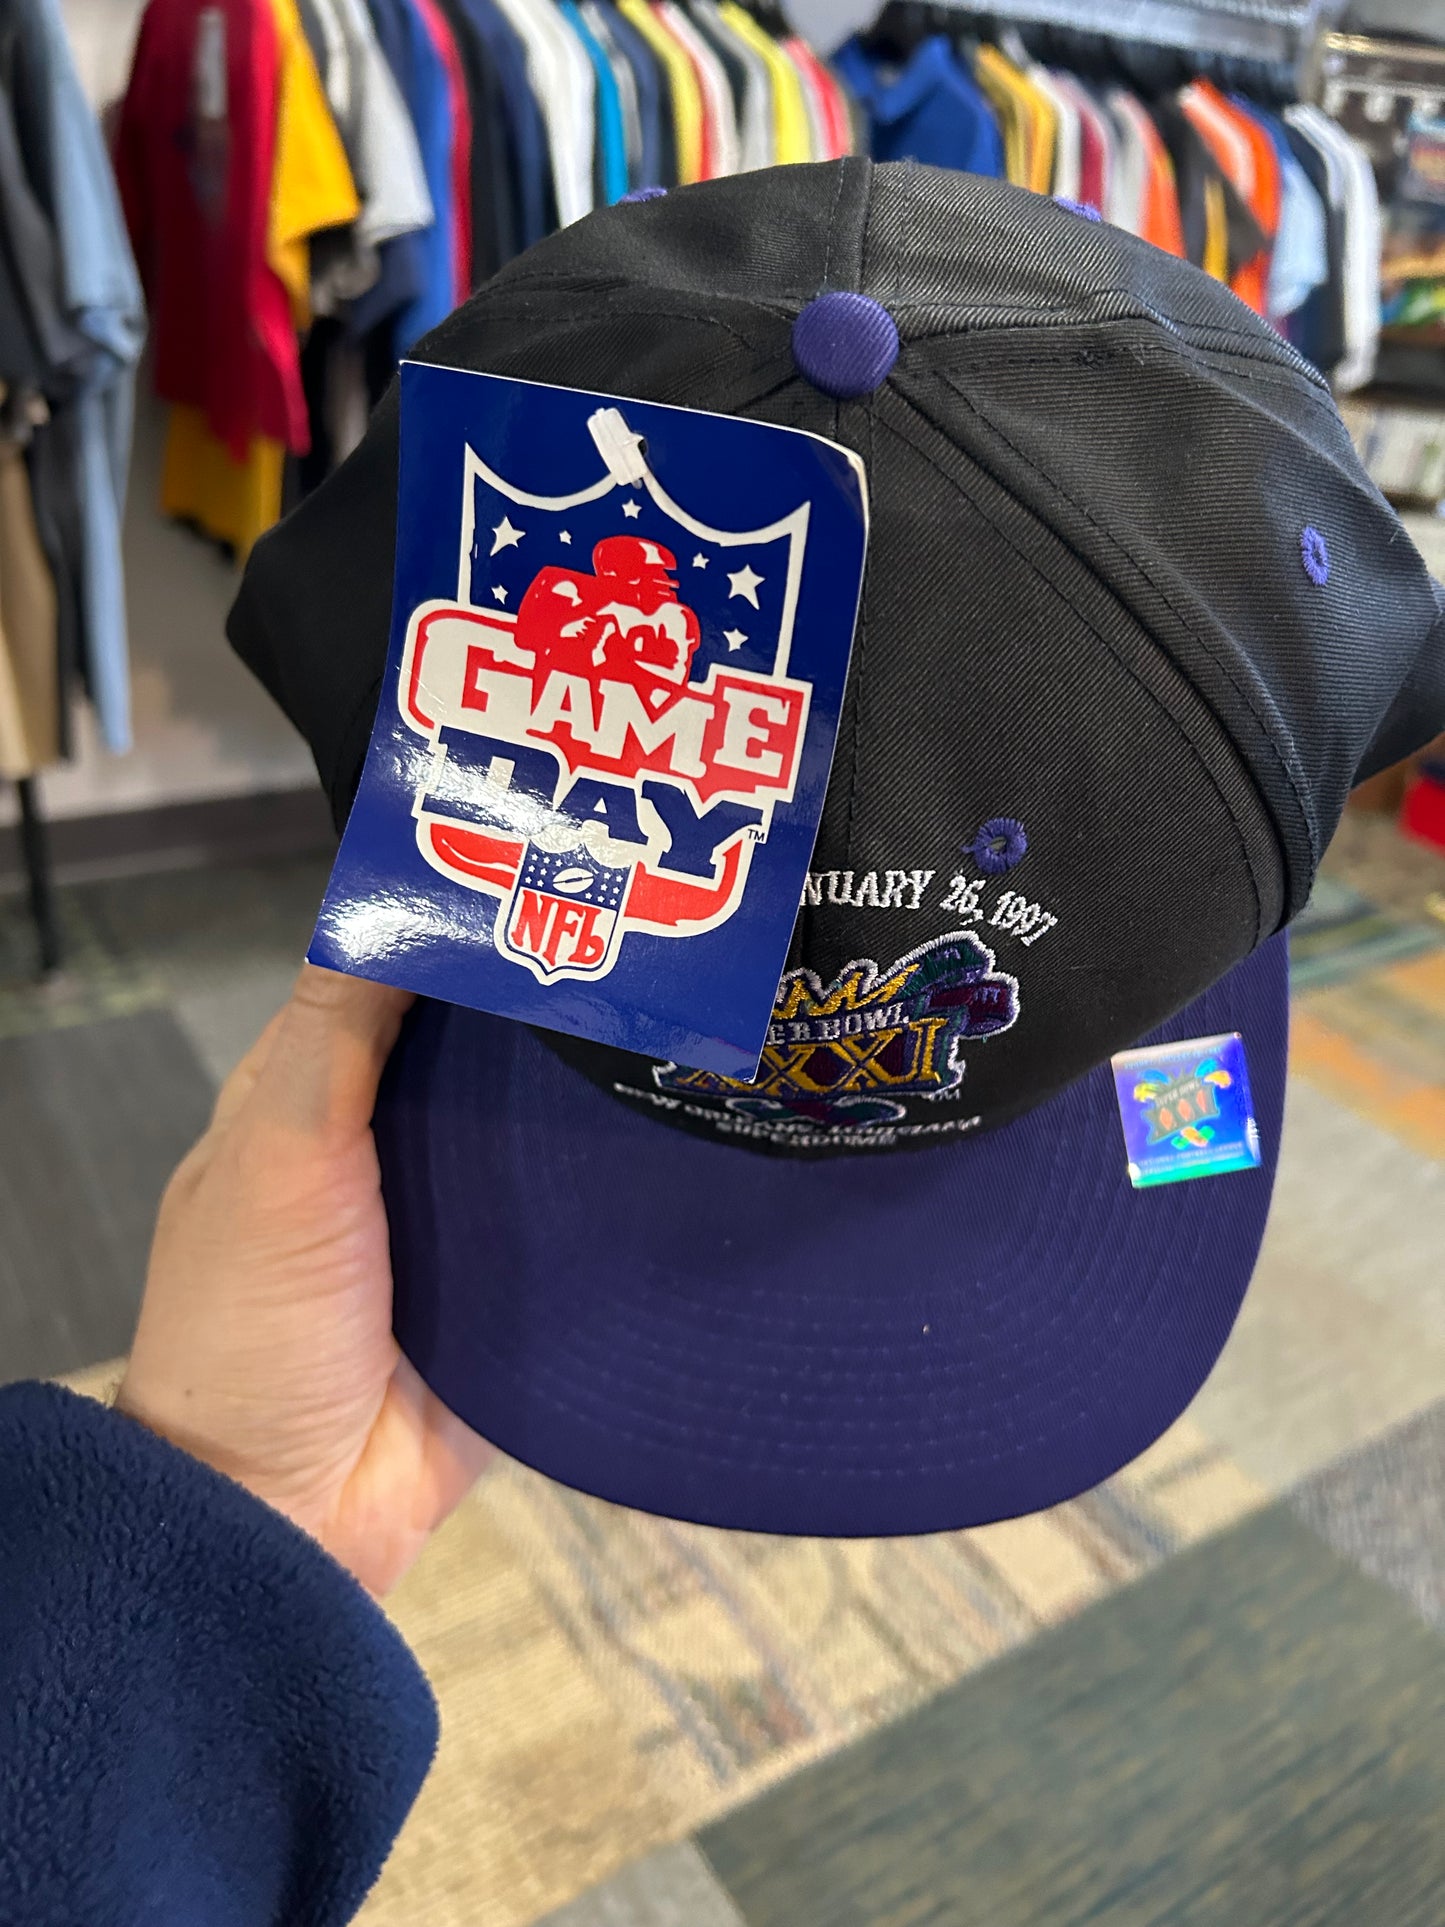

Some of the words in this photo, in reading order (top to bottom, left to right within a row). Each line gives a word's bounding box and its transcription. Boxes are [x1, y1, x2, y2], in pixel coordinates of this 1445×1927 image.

[416, 617, 790, 779] GAME
[421, 725, 763, 880] DAY
[747, 829, 766, 843] TM
[511, 890, 605, 966] NFL
[800, 870, 936, 909] NUARY
[988, 891, 1058, 946] 1997
[815, 1002, 909, 1040] BOWL
